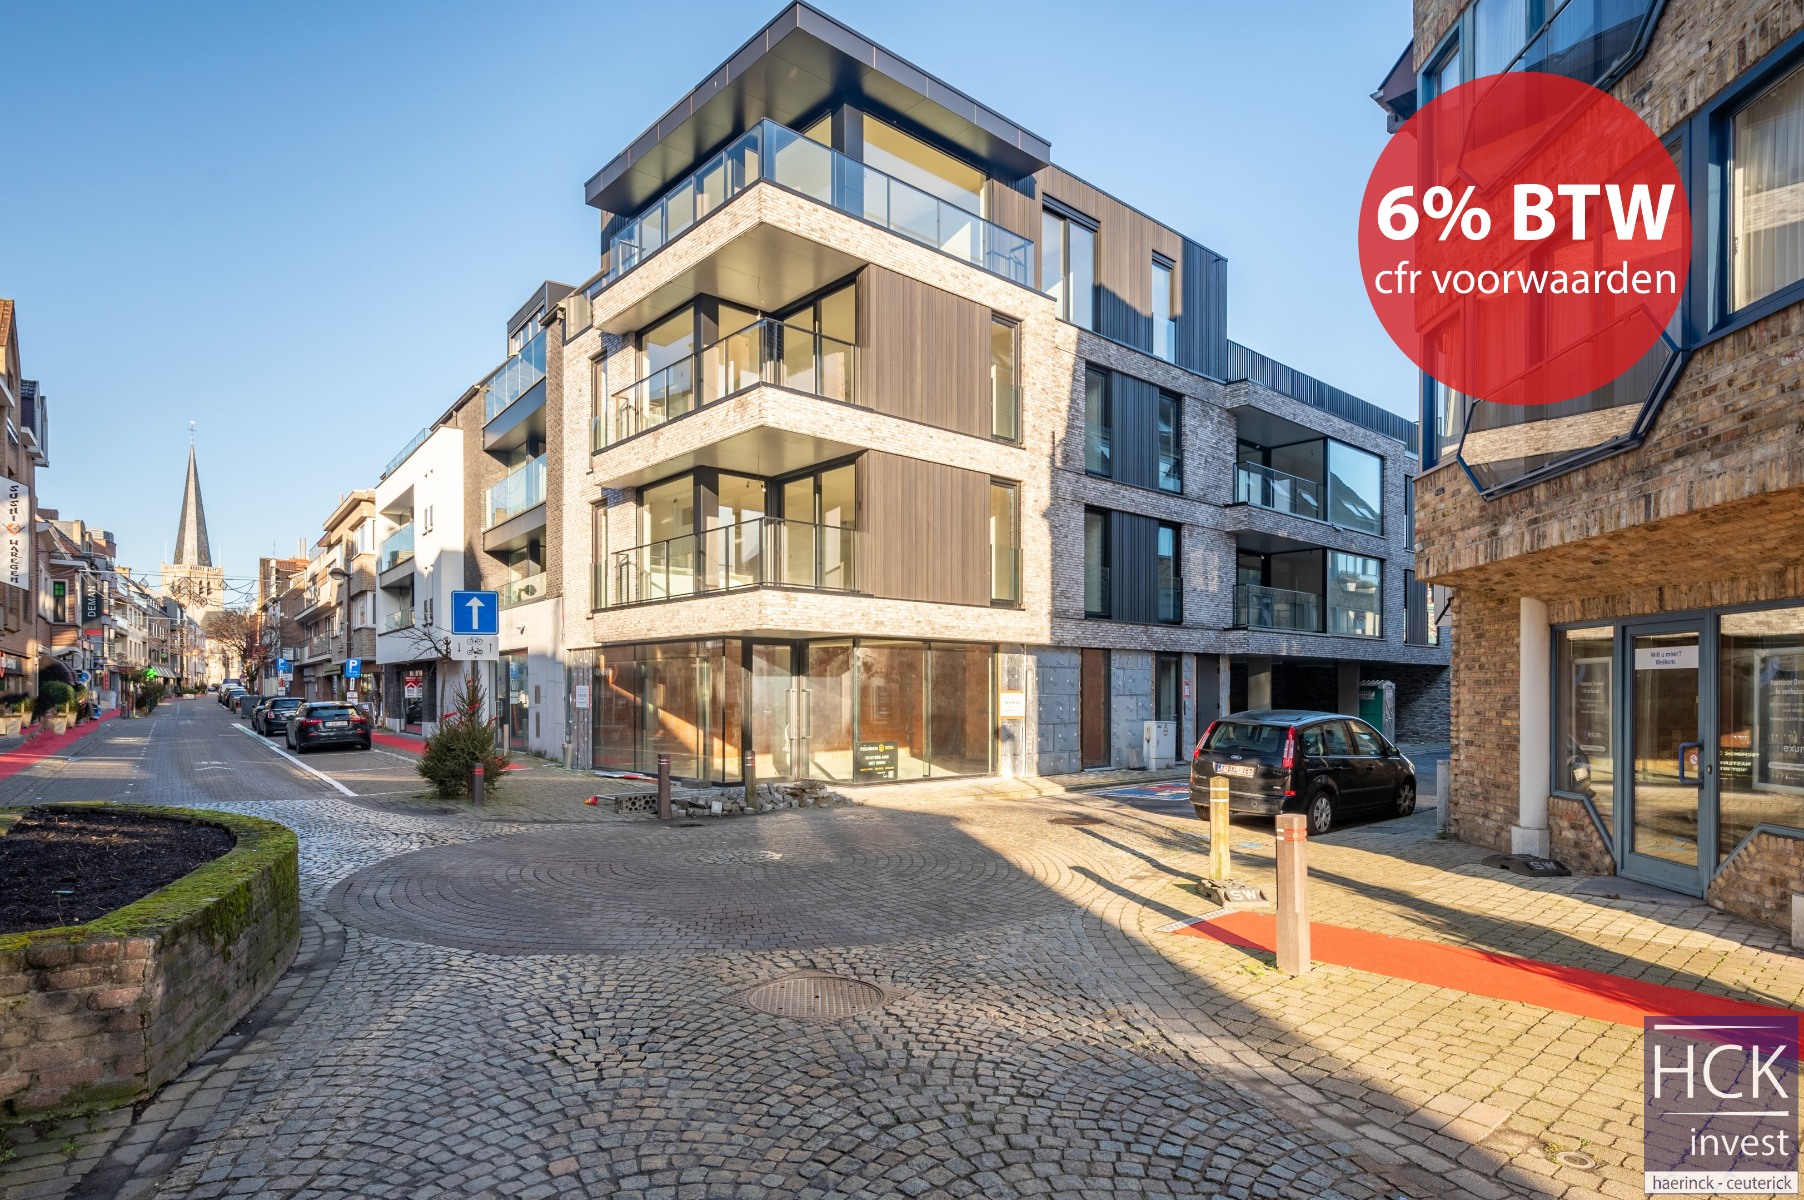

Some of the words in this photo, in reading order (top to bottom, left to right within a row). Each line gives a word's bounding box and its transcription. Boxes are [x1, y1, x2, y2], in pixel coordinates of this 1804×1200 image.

[9, 485, 19, 521] SUSHI
[9, 540, 19, 583] WAREGEM
[87, 585, 97, 617] DEMAN
[349, 660, 358, 670] P
[1530, 861, 1557, 870] SW
[1230, 889, 1257, 900] SW
